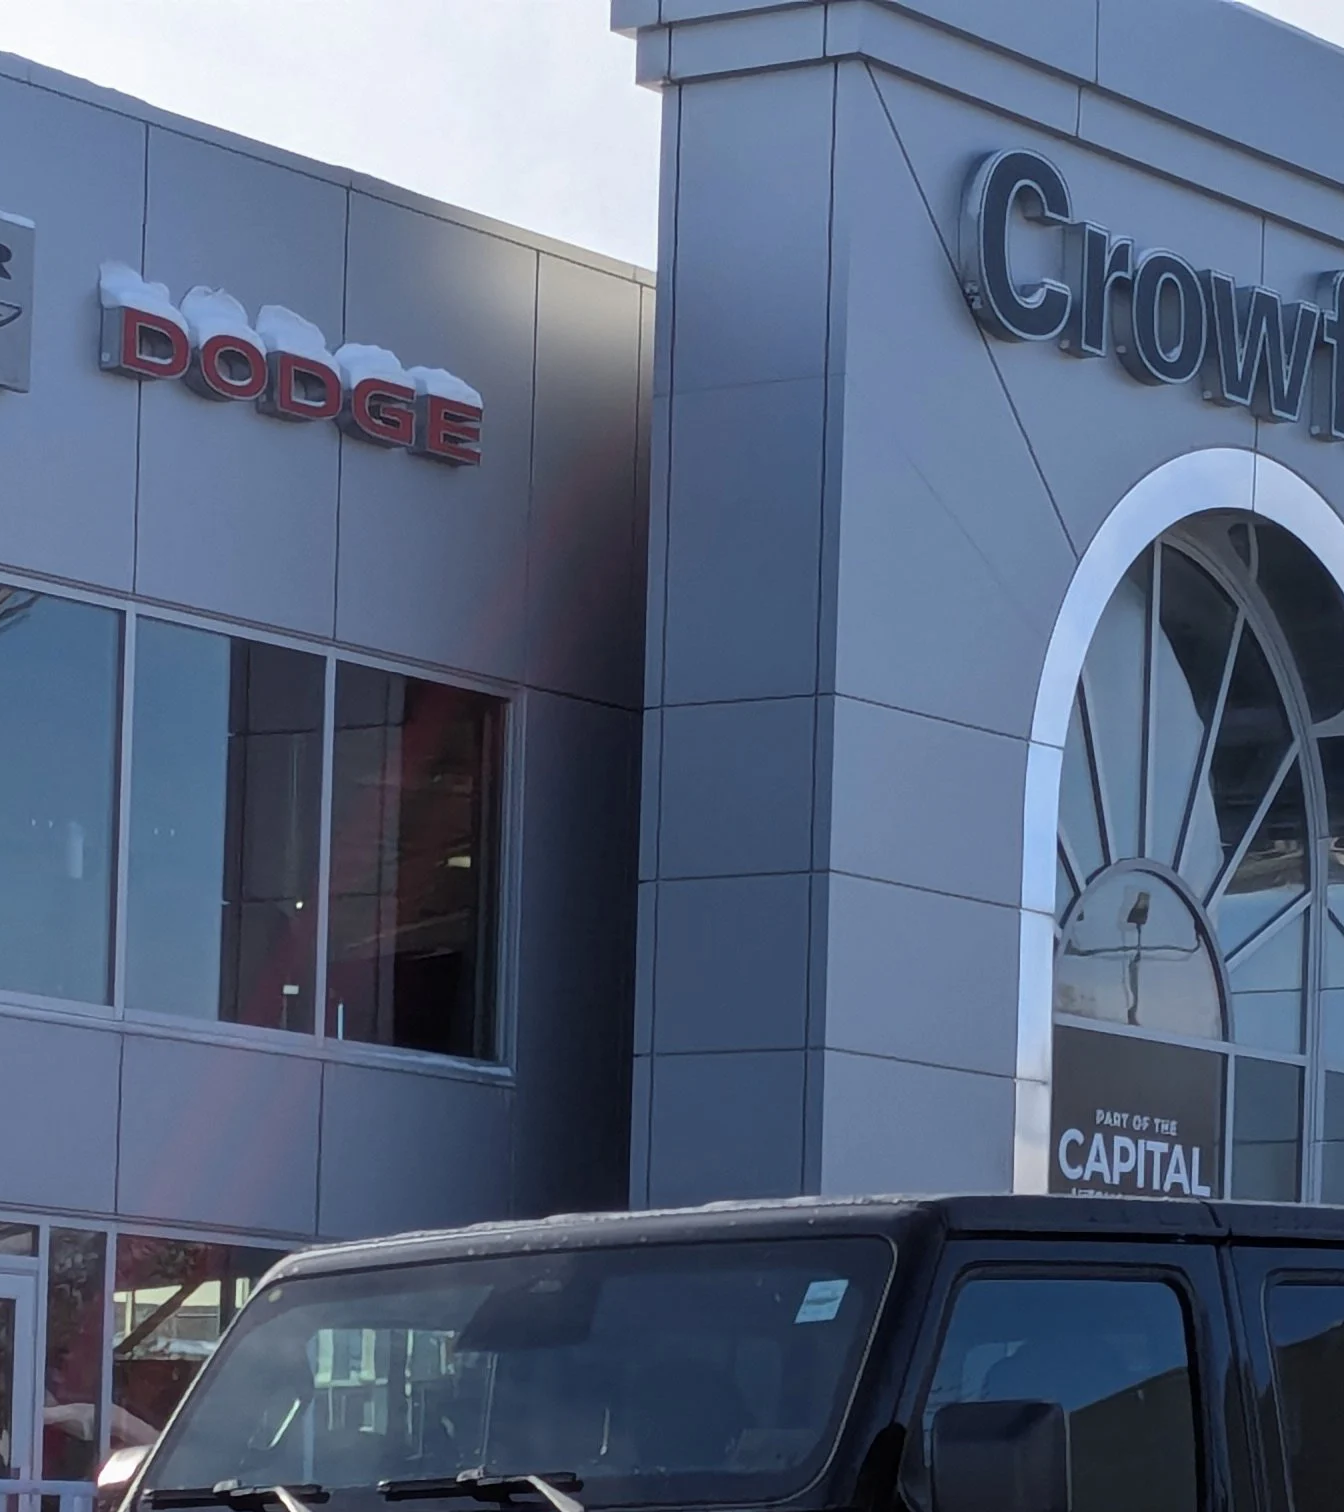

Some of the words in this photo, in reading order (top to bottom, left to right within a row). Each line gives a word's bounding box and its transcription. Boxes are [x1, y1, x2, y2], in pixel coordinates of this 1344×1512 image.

[118, 304, 484, 467] DODGE
[1095, 1109, 1130, 1129] PART
[1132, 1114, 1151, 1131] OF
[1154, 1117, 1179, 1137] THE
[1058, 1128, 1211, 1198] CAPITAL
